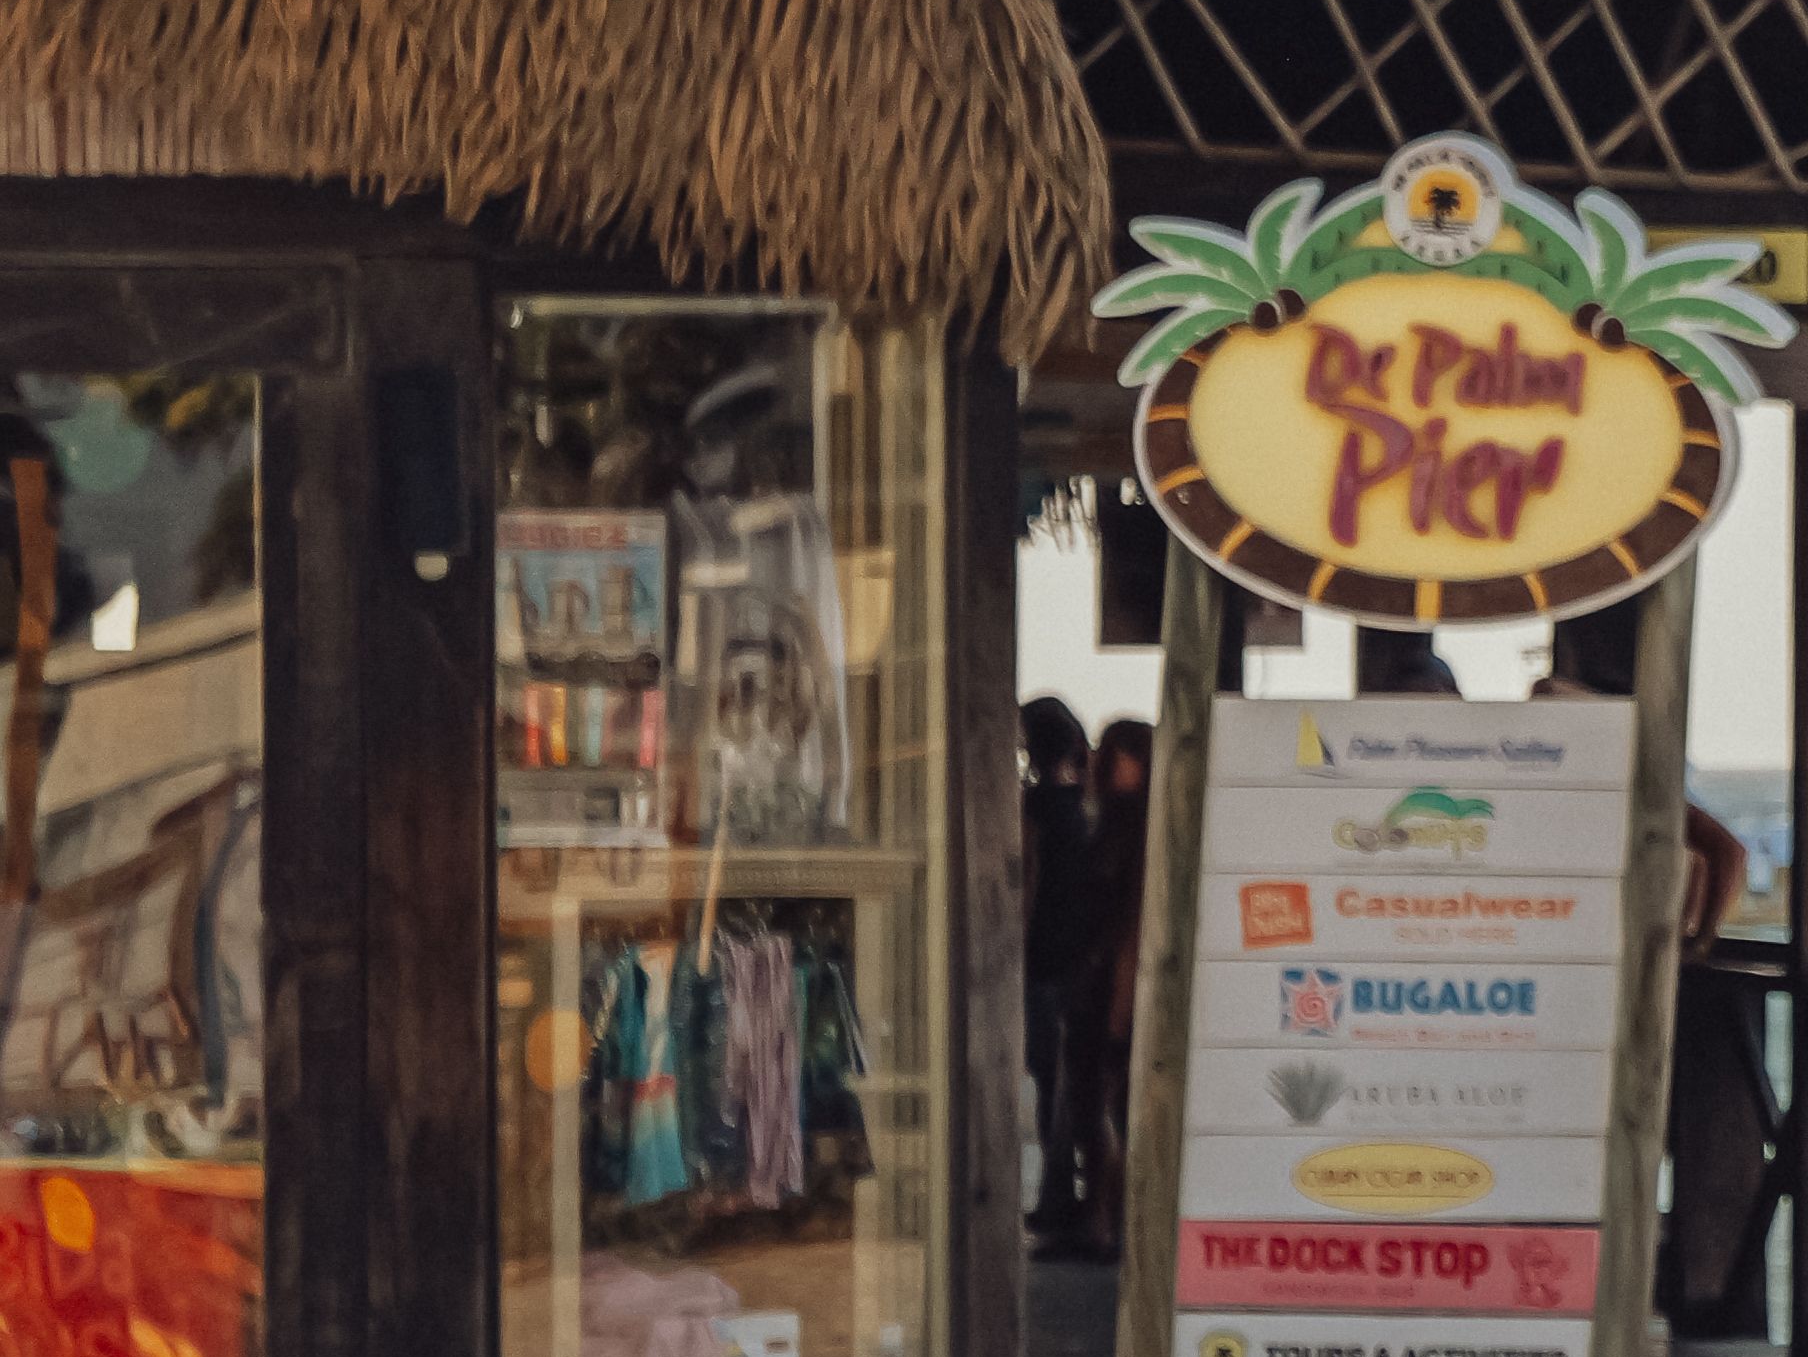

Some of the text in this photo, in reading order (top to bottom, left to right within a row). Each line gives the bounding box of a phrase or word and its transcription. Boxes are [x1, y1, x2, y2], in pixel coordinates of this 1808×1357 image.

[1303, 323, 1587, 416] De Palm
[1318, 403, 1565, 548] Pier
[1353, 978, 1537, 1016] BUGALOE
[1202, 1233, 1261, 1271] THE
[1266, 1237, 1367, 1274] DOCK
